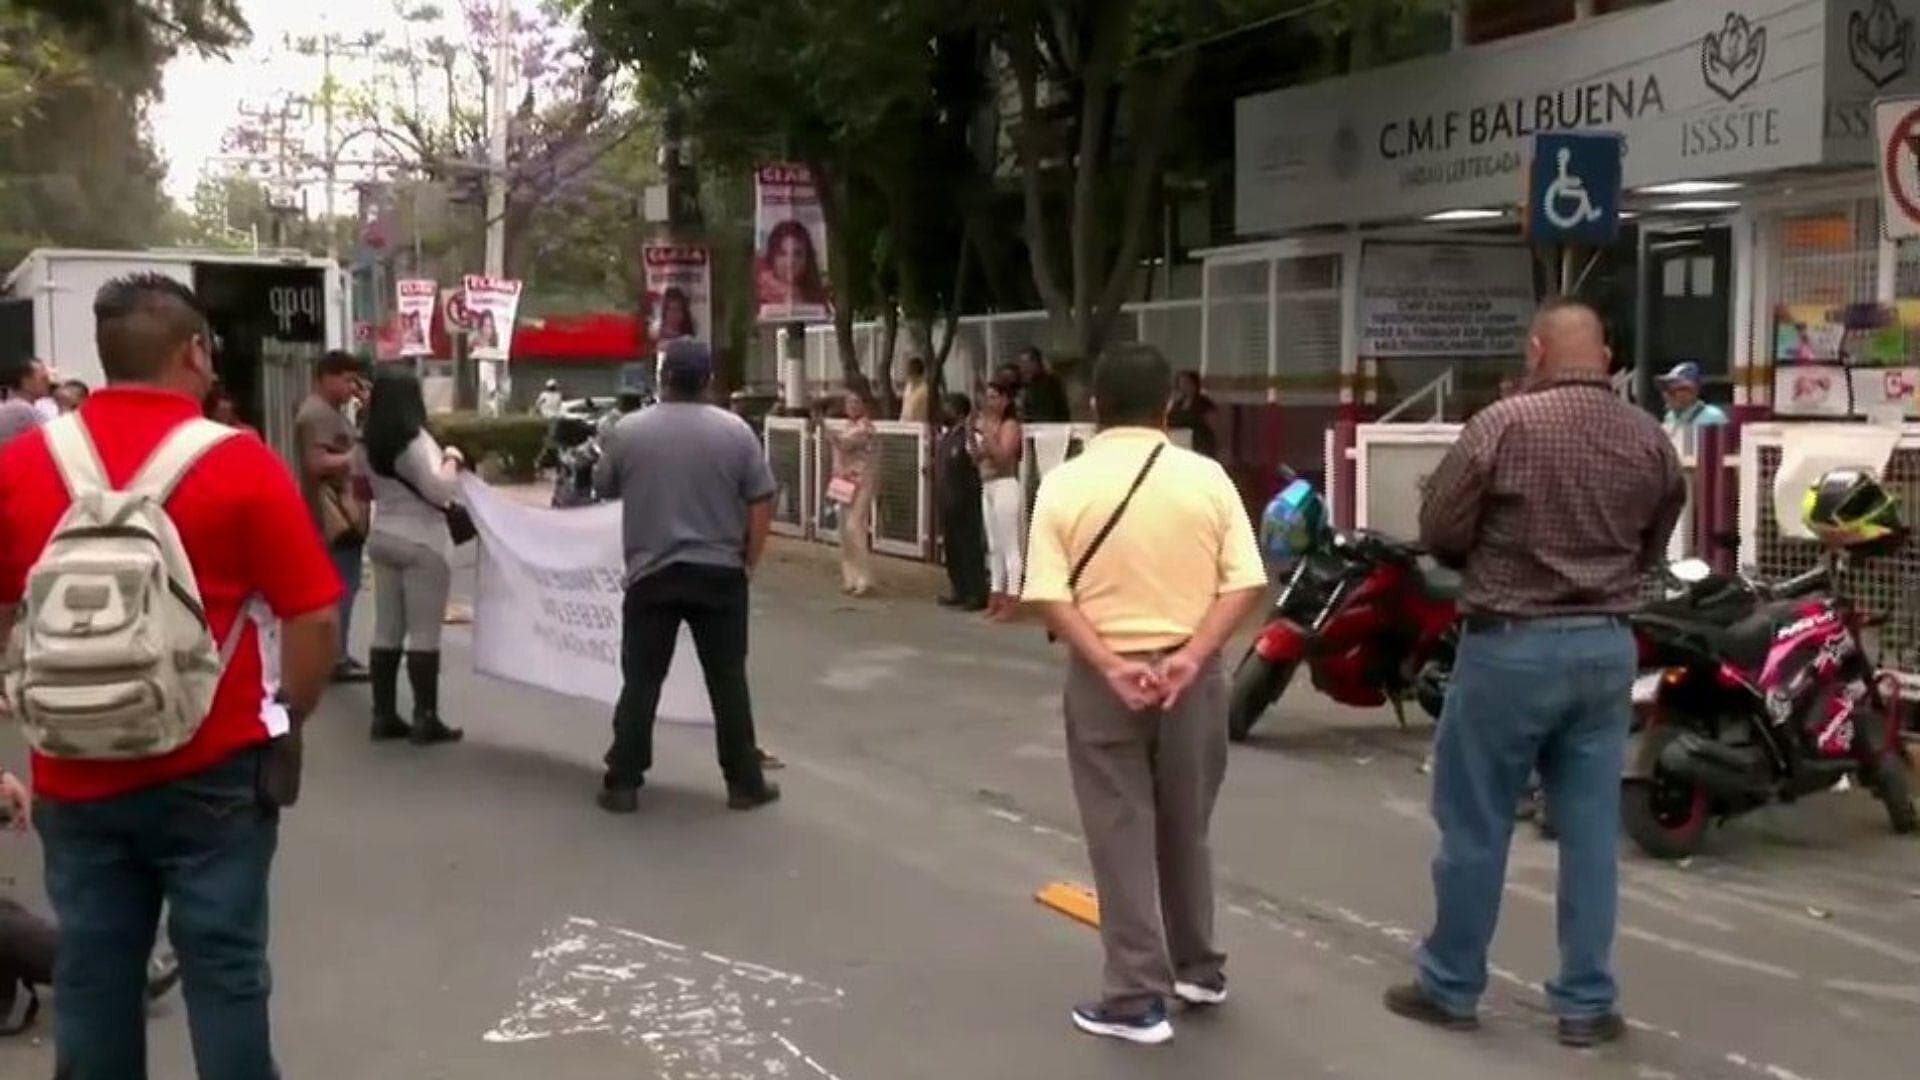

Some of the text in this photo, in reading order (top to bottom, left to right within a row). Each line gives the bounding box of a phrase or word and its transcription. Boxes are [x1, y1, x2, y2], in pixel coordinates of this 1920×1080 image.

[1379, 110, 1460, 160] C.M.F
[1469, 72, 1665, 145] BALBUENA
[1681, 107, 1780, 158] ISSSTE
